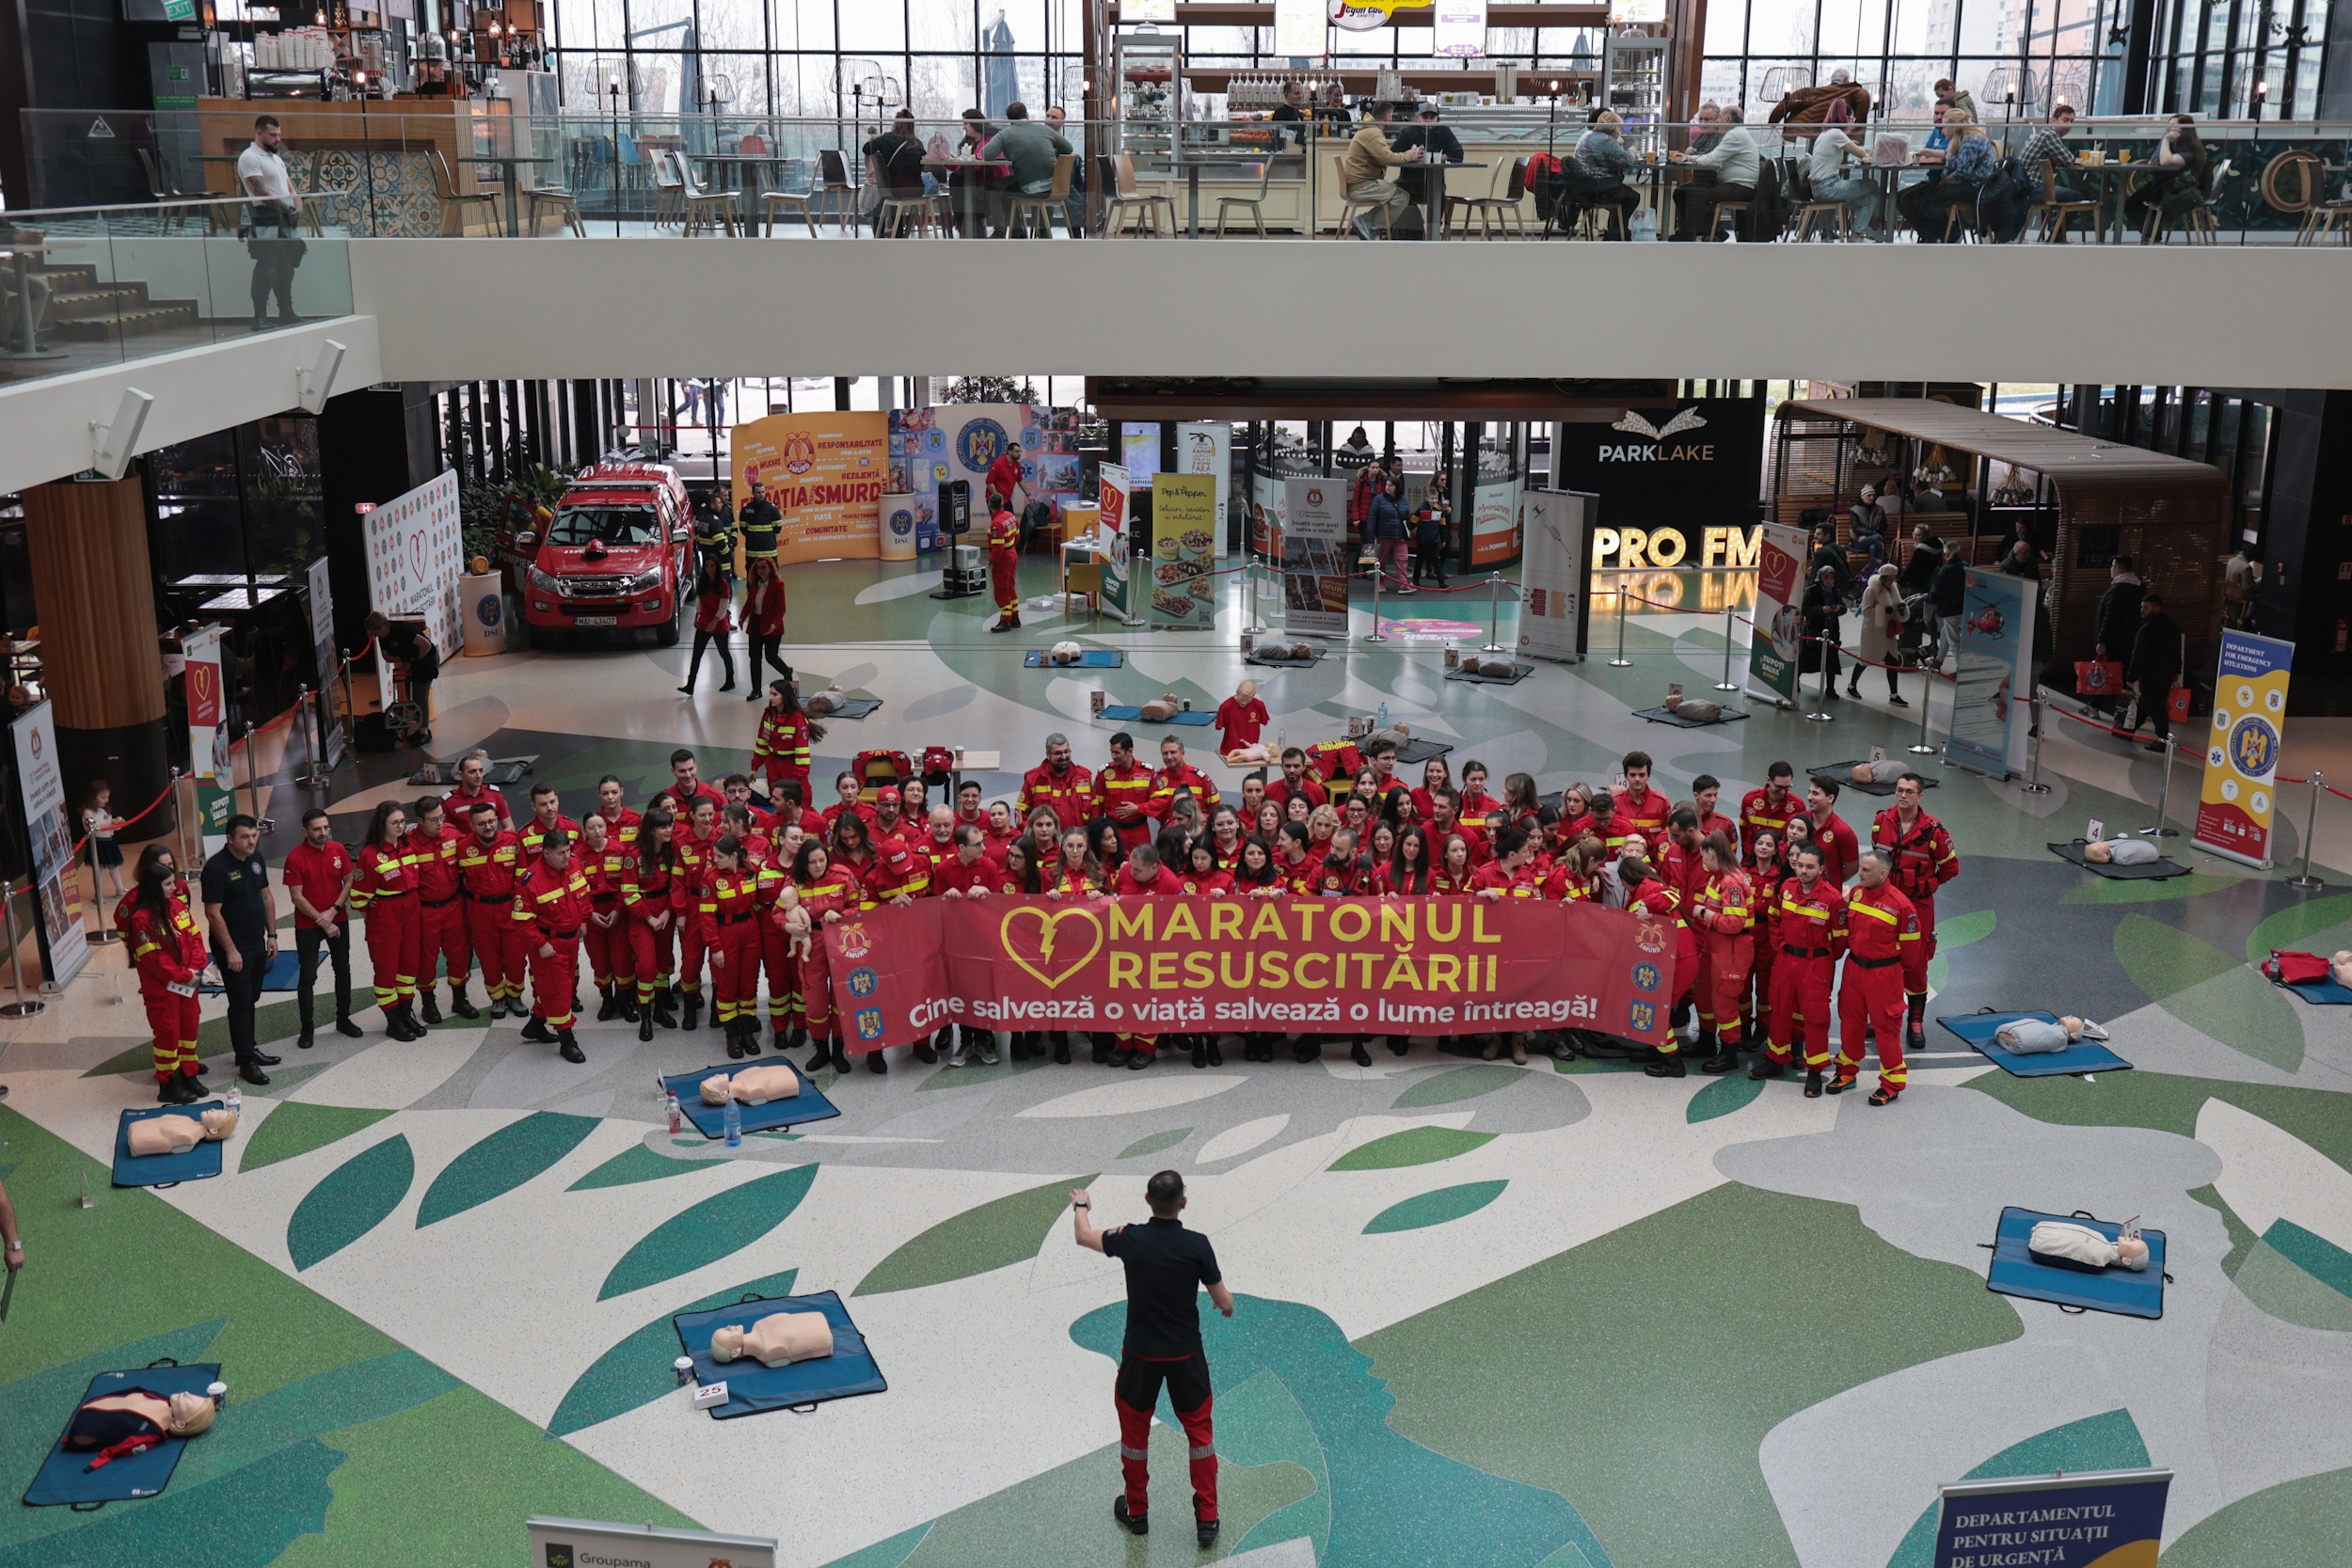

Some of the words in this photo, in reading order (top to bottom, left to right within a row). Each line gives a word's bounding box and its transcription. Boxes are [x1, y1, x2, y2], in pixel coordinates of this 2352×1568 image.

[167, 1, 192, 17] EXIT
[818, 439, 882, 450] RESPONSABILITATE
[1598, 444, 1715, 462] PARKLAKE
[788, 463, 810, 474] SMURD
[841, 469, 880, 481] REZILIENȚĂ
[814, 483, 882, 505] SMURD
[1162, 487, 1175, 499] Pep
[1180, 485, 1207, 499] Pepper
[813, 513, 833, 522] VIAȚĂ
[1292, 519, 1311, 528] Învață
[805, 525, 848, 534] COMUNITATE
[895, 536, 910, 545] DSU
[1488, 541, 1507, 550] POPEYES
[1591, 526, 1687, 567] PRO
[1701, 524, 1764, 567] FM
[578, 617, 591, 626] MAI
[593, 617, 615, 626] 43407
[1245, 641, 1251, 649] 8
[2226, 642, 2265, 657] DEPARTMENT
[1040, 656, 1049, 665] 28
[1450, 655, 1456, 664] 7
[1762, 654, 1771, 664] TU
[1770, 656, 1785, 672] POȚI
[2225, 651, 2236, 659] FOR
[2237, 654, 2272, 668] EMERGENCY
[1761, 662, 1780, 675] SALVA
[2223, 659, 2258, 673] SITUATIONS
[1092, 698, 1104, 707] 21
[1349, 723, 1359, 735] 20
[1873, 752, 1881, 762] 5
[425, 770, 437, 784] 11
[40, 782, 50, 793] cum
[212, 809, 228, 821] SALVA
[2091, 827, 2099, 839] 4
[1109, 902, 1502, 942] MARATONUL
[845, 947, 868, 958] SMURD
[1638, 942, 1661, 954] SMURD
[1108, 942, 1498, 992] RESUSCITĂRII
[909, 995, 965, 1028] Cine
[972, 994, 1095, 1021] salvează
[1104, 1001, 1124, 1020] o
[1132, 996, 1206, 1028] viață
[1215, 996, 1341, 1022] salvează
[1349, 1002, 1369, 1021] o
[1378, 998, 1455, 1023] lume
[1464, 994, 1597, 1022] întreagă!
[699, 1386, 722, 1398] 25
[1955, 1505, 2116, 1528] DEPARTAMENTUL
[1953, 1531, 2027, 1549] PENTRU
[2030, 1526, 2109, 1544] SITUAȚII
[580, 1553, 651, 1568] Groupama
[1951, 1557, 1976, 1568] DE
[1979, 1546, 2066, 1567] URGENȚĂ
